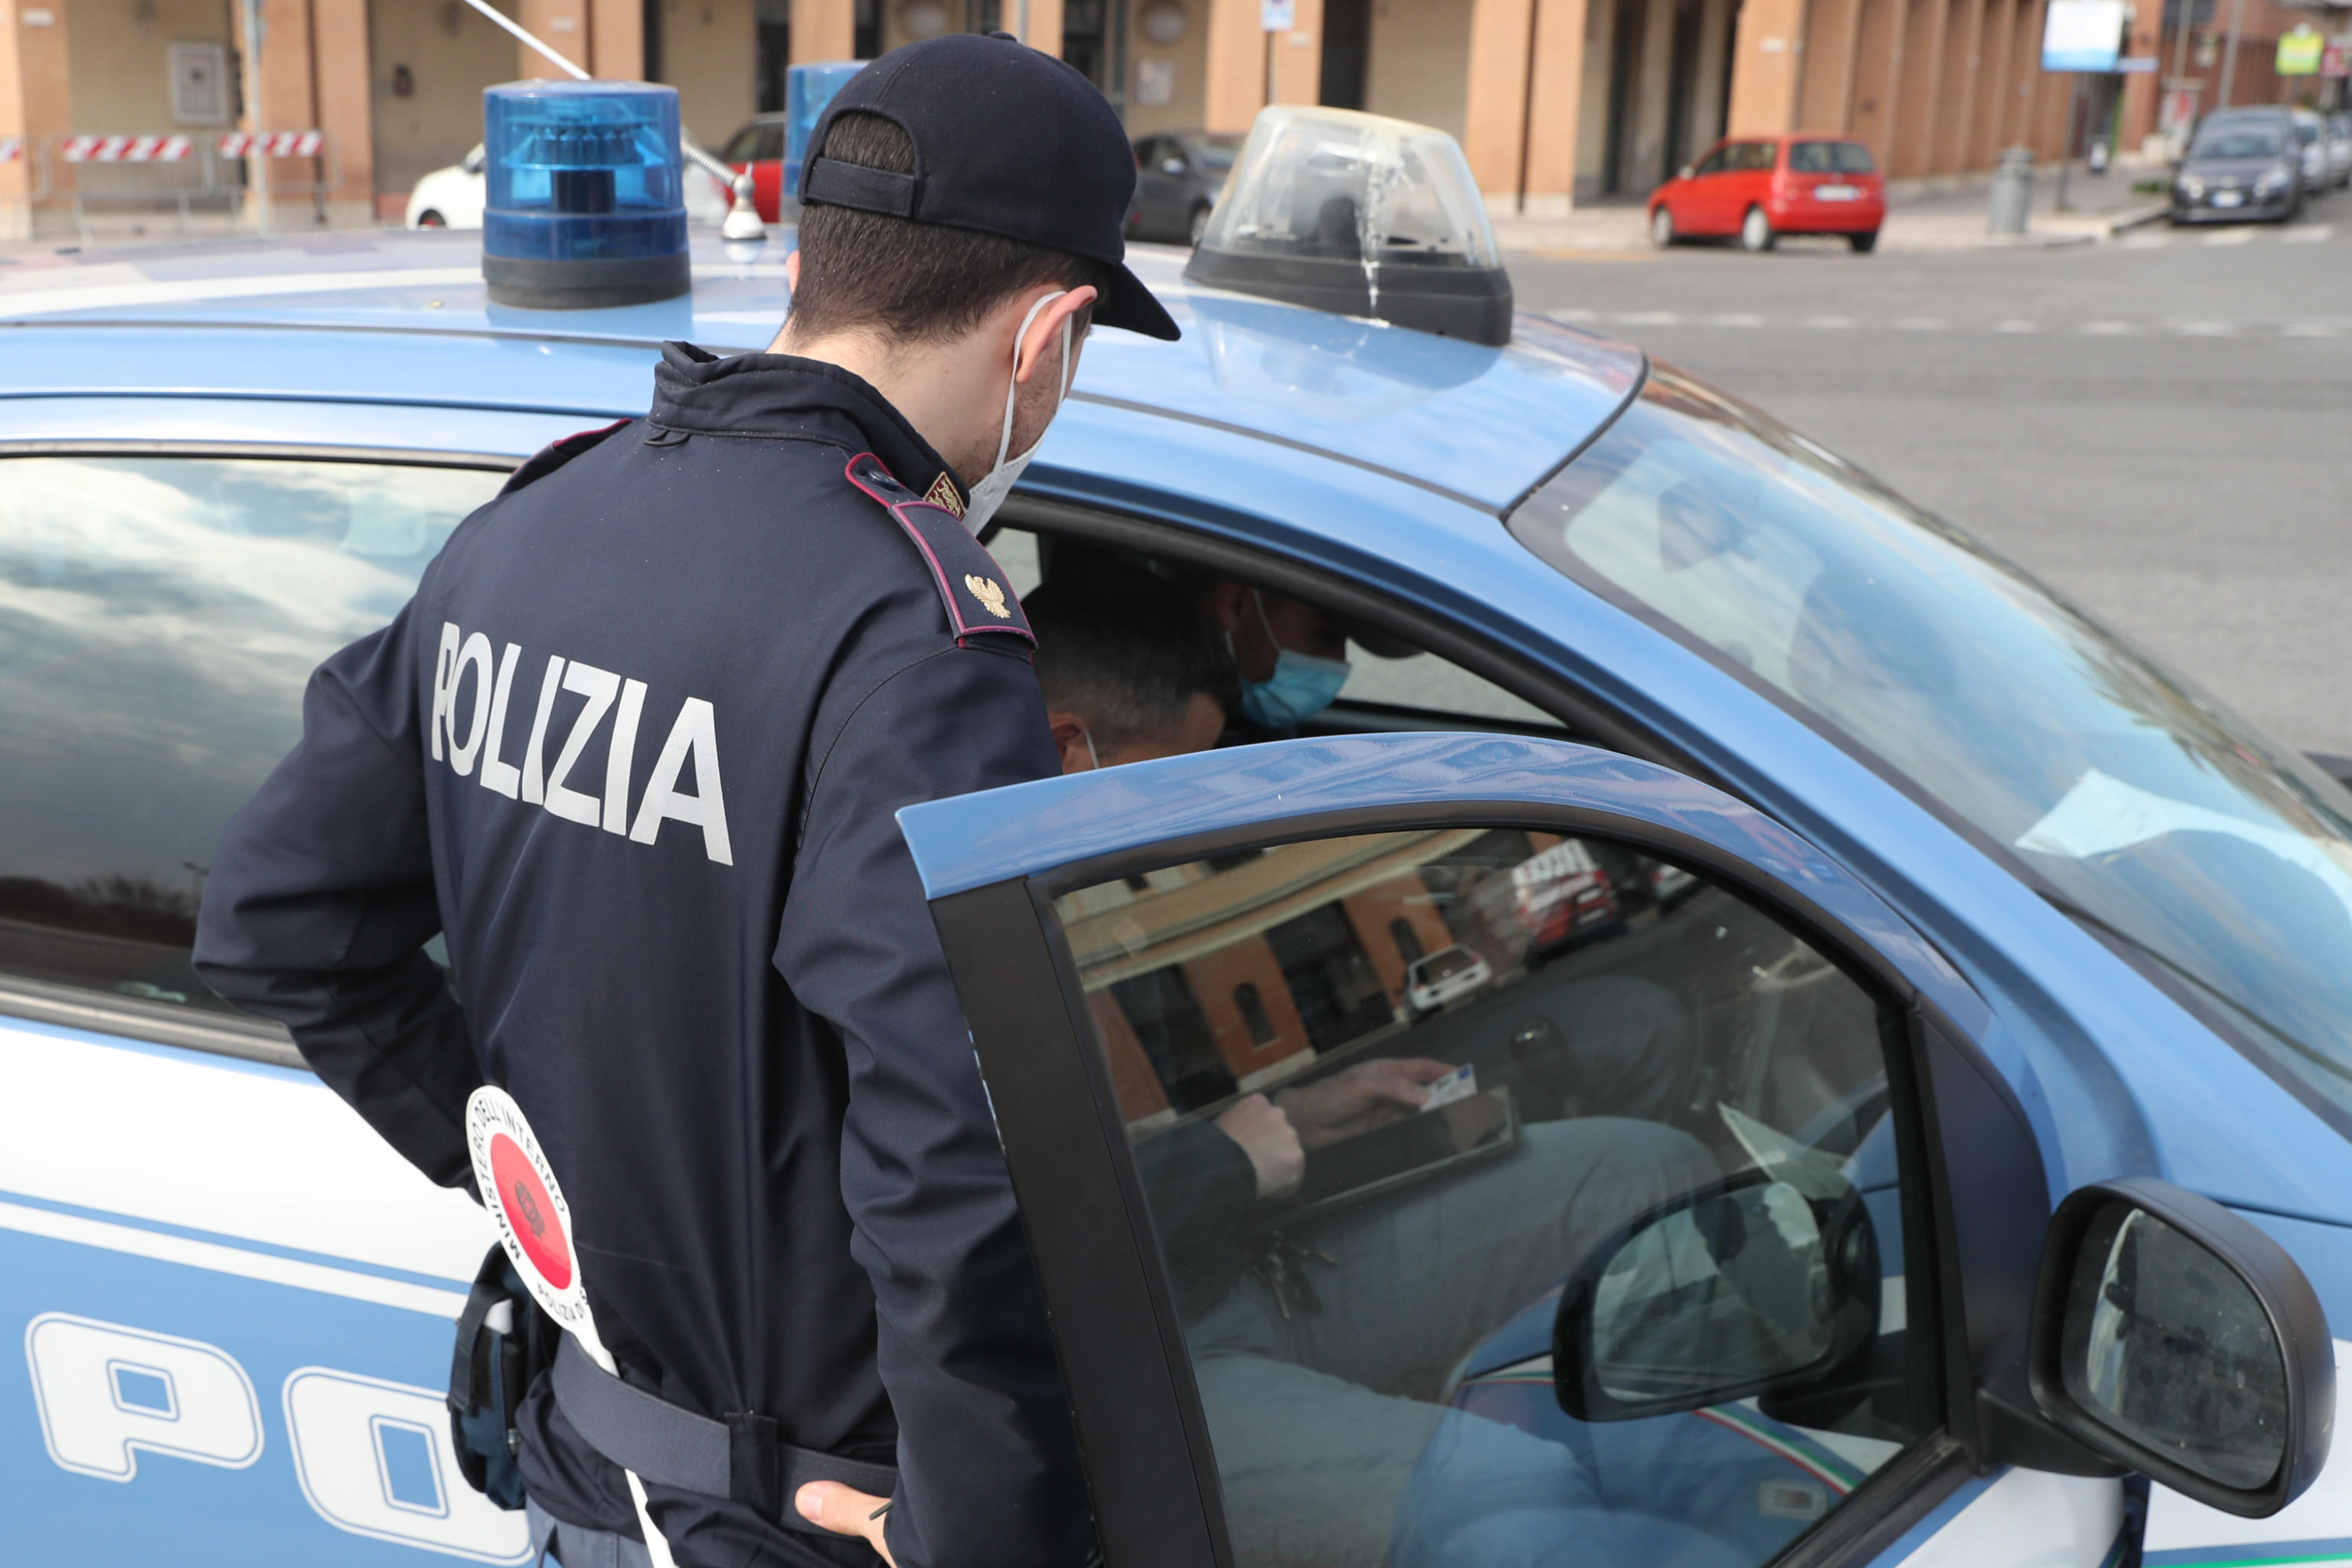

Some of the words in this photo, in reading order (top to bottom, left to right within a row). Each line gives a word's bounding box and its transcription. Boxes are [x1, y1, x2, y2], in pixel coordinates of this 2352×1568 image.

[432, 621, 733, 866] POLIZIA
[472, 1122, 522, 1259] MINISTERO
[474, 1097, 565, 1213] DELL'INTERNO
[537, 1282, 577, 1321] POLIZIA
[24, 1311, 535, 1566] PO
